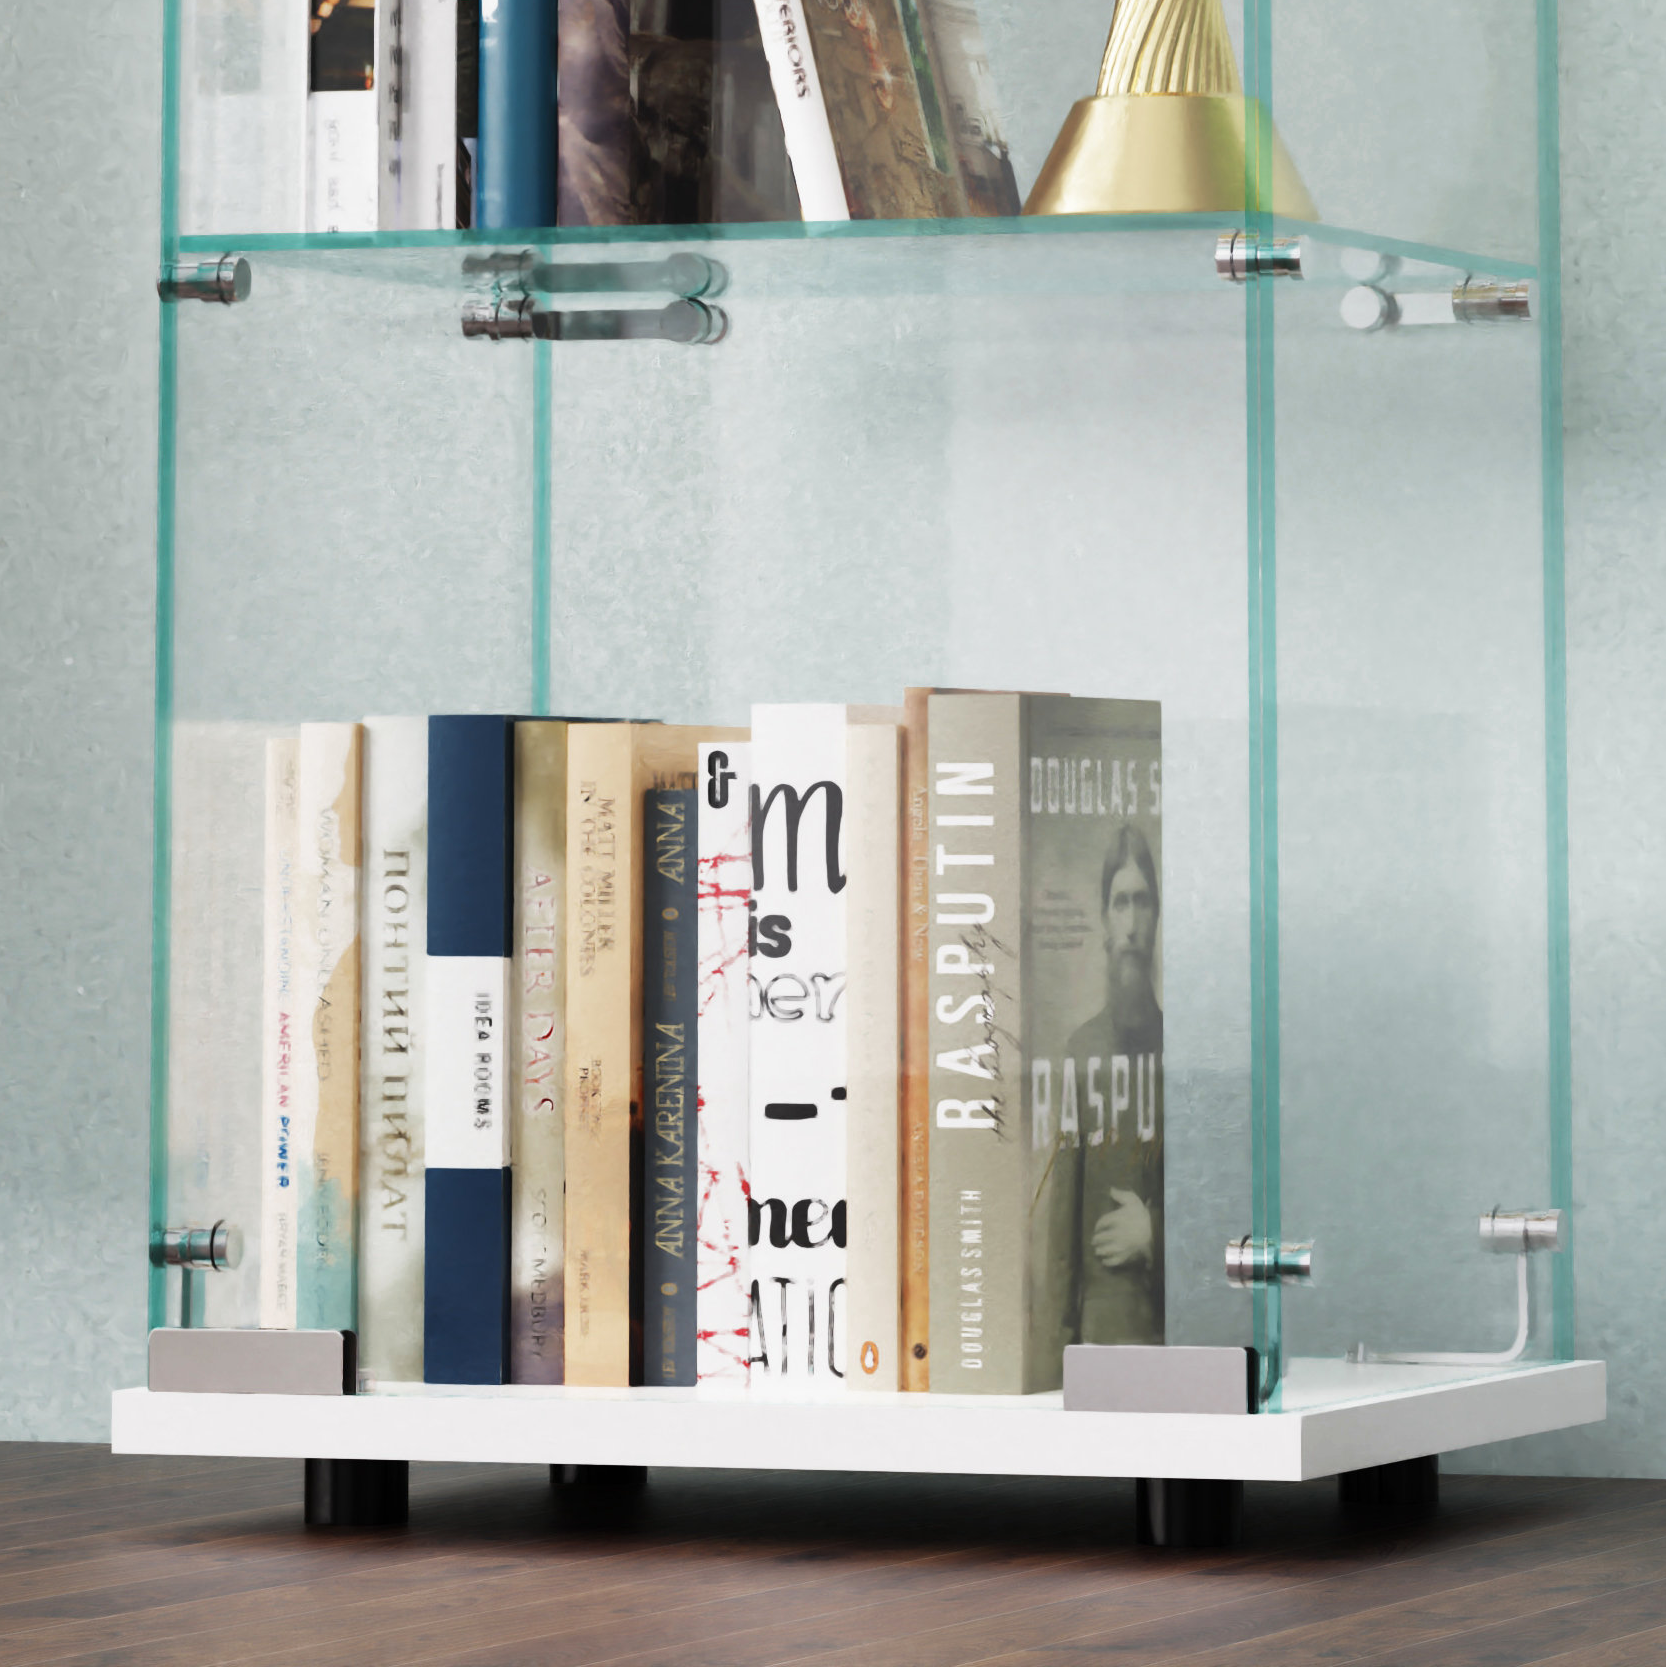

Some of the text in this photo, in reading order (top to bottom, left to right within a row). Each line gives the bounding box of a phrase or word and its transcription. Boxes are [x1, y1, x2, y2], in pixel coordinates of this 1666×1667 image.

[655, 801, 687, 886] ANNA
[1030, 756, 1161, 816] DOUGLAS S
[523, 863, 556, 998] AFTER
[596, 797, 617, 953] MATT MILLER
[382, 848, 418, 1057] ПОНТИЙ
[936, 761, 995, 1130] RASPUTIN
[474, 992, 493, 1132] IDEA ROOMS
[521, 1010, 556, 1118] DAYS
[654, 1021, 687, 1167] KARENINA
[1031, 1052, 1157, 1153] RASPU
[274, 1115, 291, 1189] POWER
[654, 1176, 687, 1261] ANNA
[960, 1189, 984, 1369] DOUGLAS SMITH
